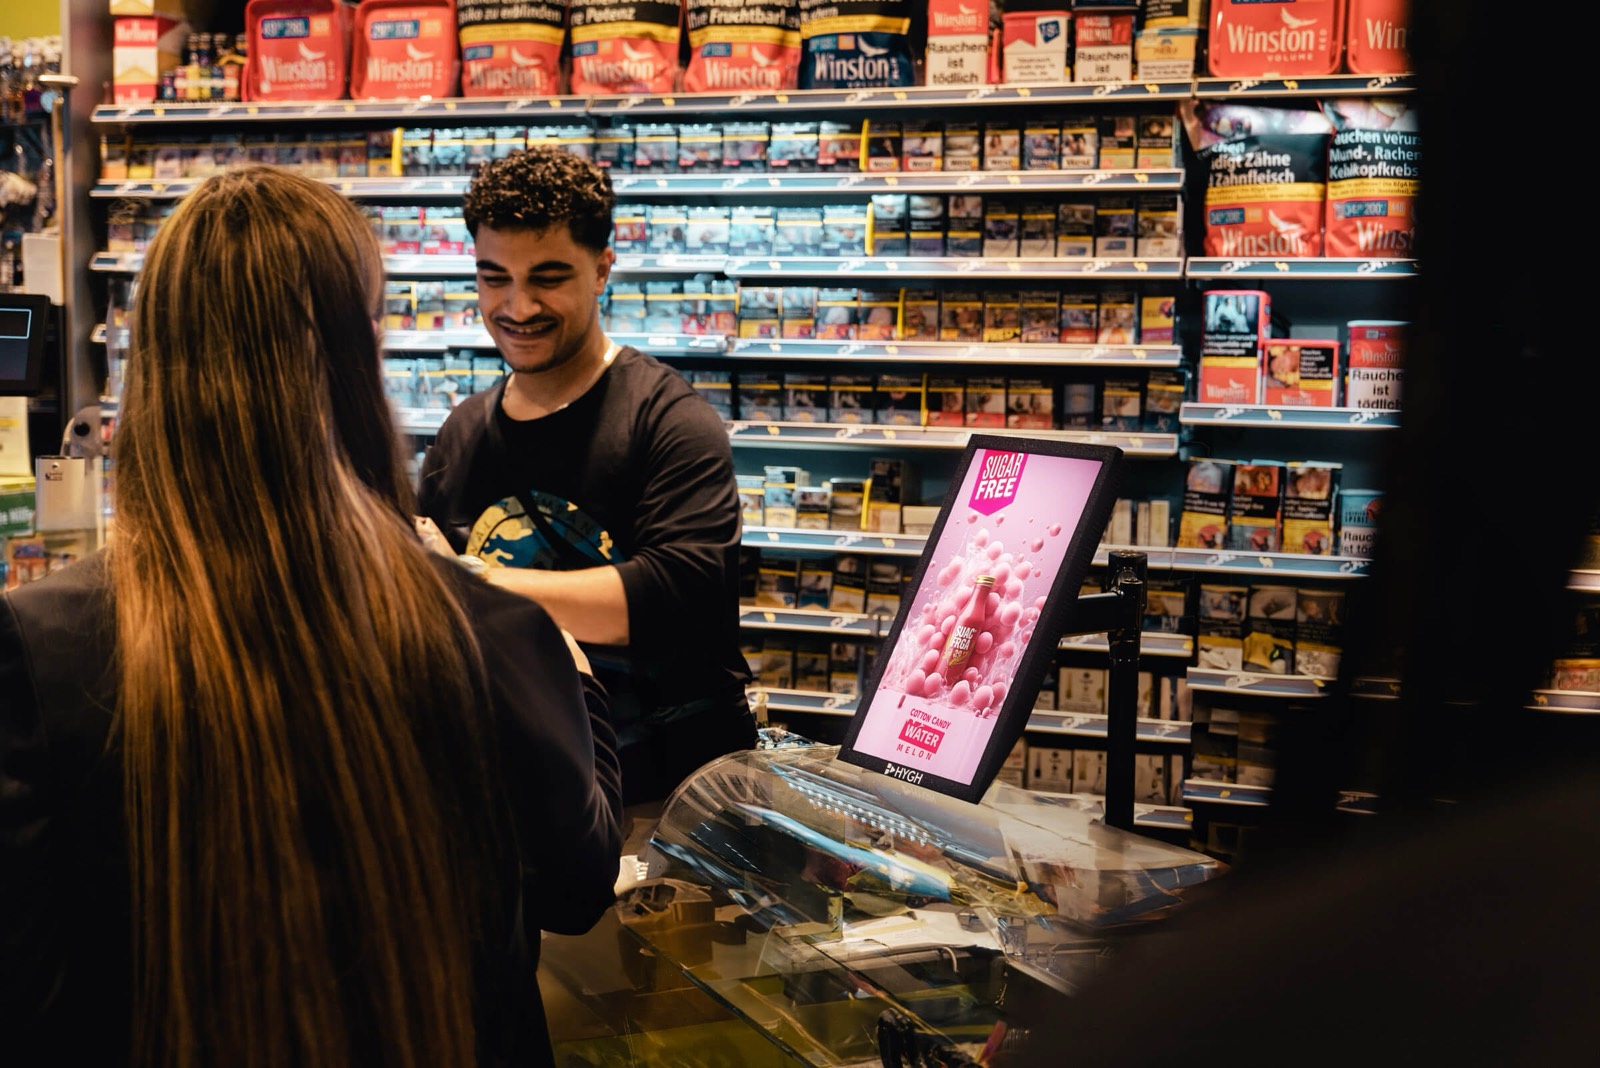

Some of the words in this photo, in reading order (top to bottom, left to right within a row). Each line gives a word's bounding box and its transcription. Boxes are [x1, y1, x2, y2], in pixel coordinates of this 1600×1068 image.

[1227, 22, 1314, 53] Winston
[928, 42, 987, 54] Rauchen
[1078, 51, 1129, 61] Rauchen
[1266, 53, 1313, 62] VOLUME
[260, 55, 327, 82] Winston
[367, 57, 433, 82] Winston
[580, 56, 655, 84] Winston
[814, 52, 890, 81] Winston
[947, 57, 964, 68] ist
[470, 61, 541, 90] Winston
[705, 57, 781, 89] Winston
[933, 72, 978, 84] tödlich
[1067, 159, 1090, 167] West
[1244, 150, 1291, 168] Zähne
[1330, 145, 1371, 163] Mund-,
[1215, 168, 1295, 187] Zahnfleisch
[1330, 160, 1418, 179] Kehlkopfkrebs
[1220, 228, 1304, 255] Winston
[1361, 347, 1400, 364] Winston
[1206, 384, 1241, 398] Winston
[1373, 385, 1390, 395] ist
[983, 453, 1024, 480] SUGAR
[975, 477, 1017, 500] FREE
[910, 708, 931, 723] COTTON
[931, 716, 951, 730] CANDY
[904, 724, 939, 748] WATER
[896, 744, 933, 760] MELON
[894, 766, 924, 785] HYGH
